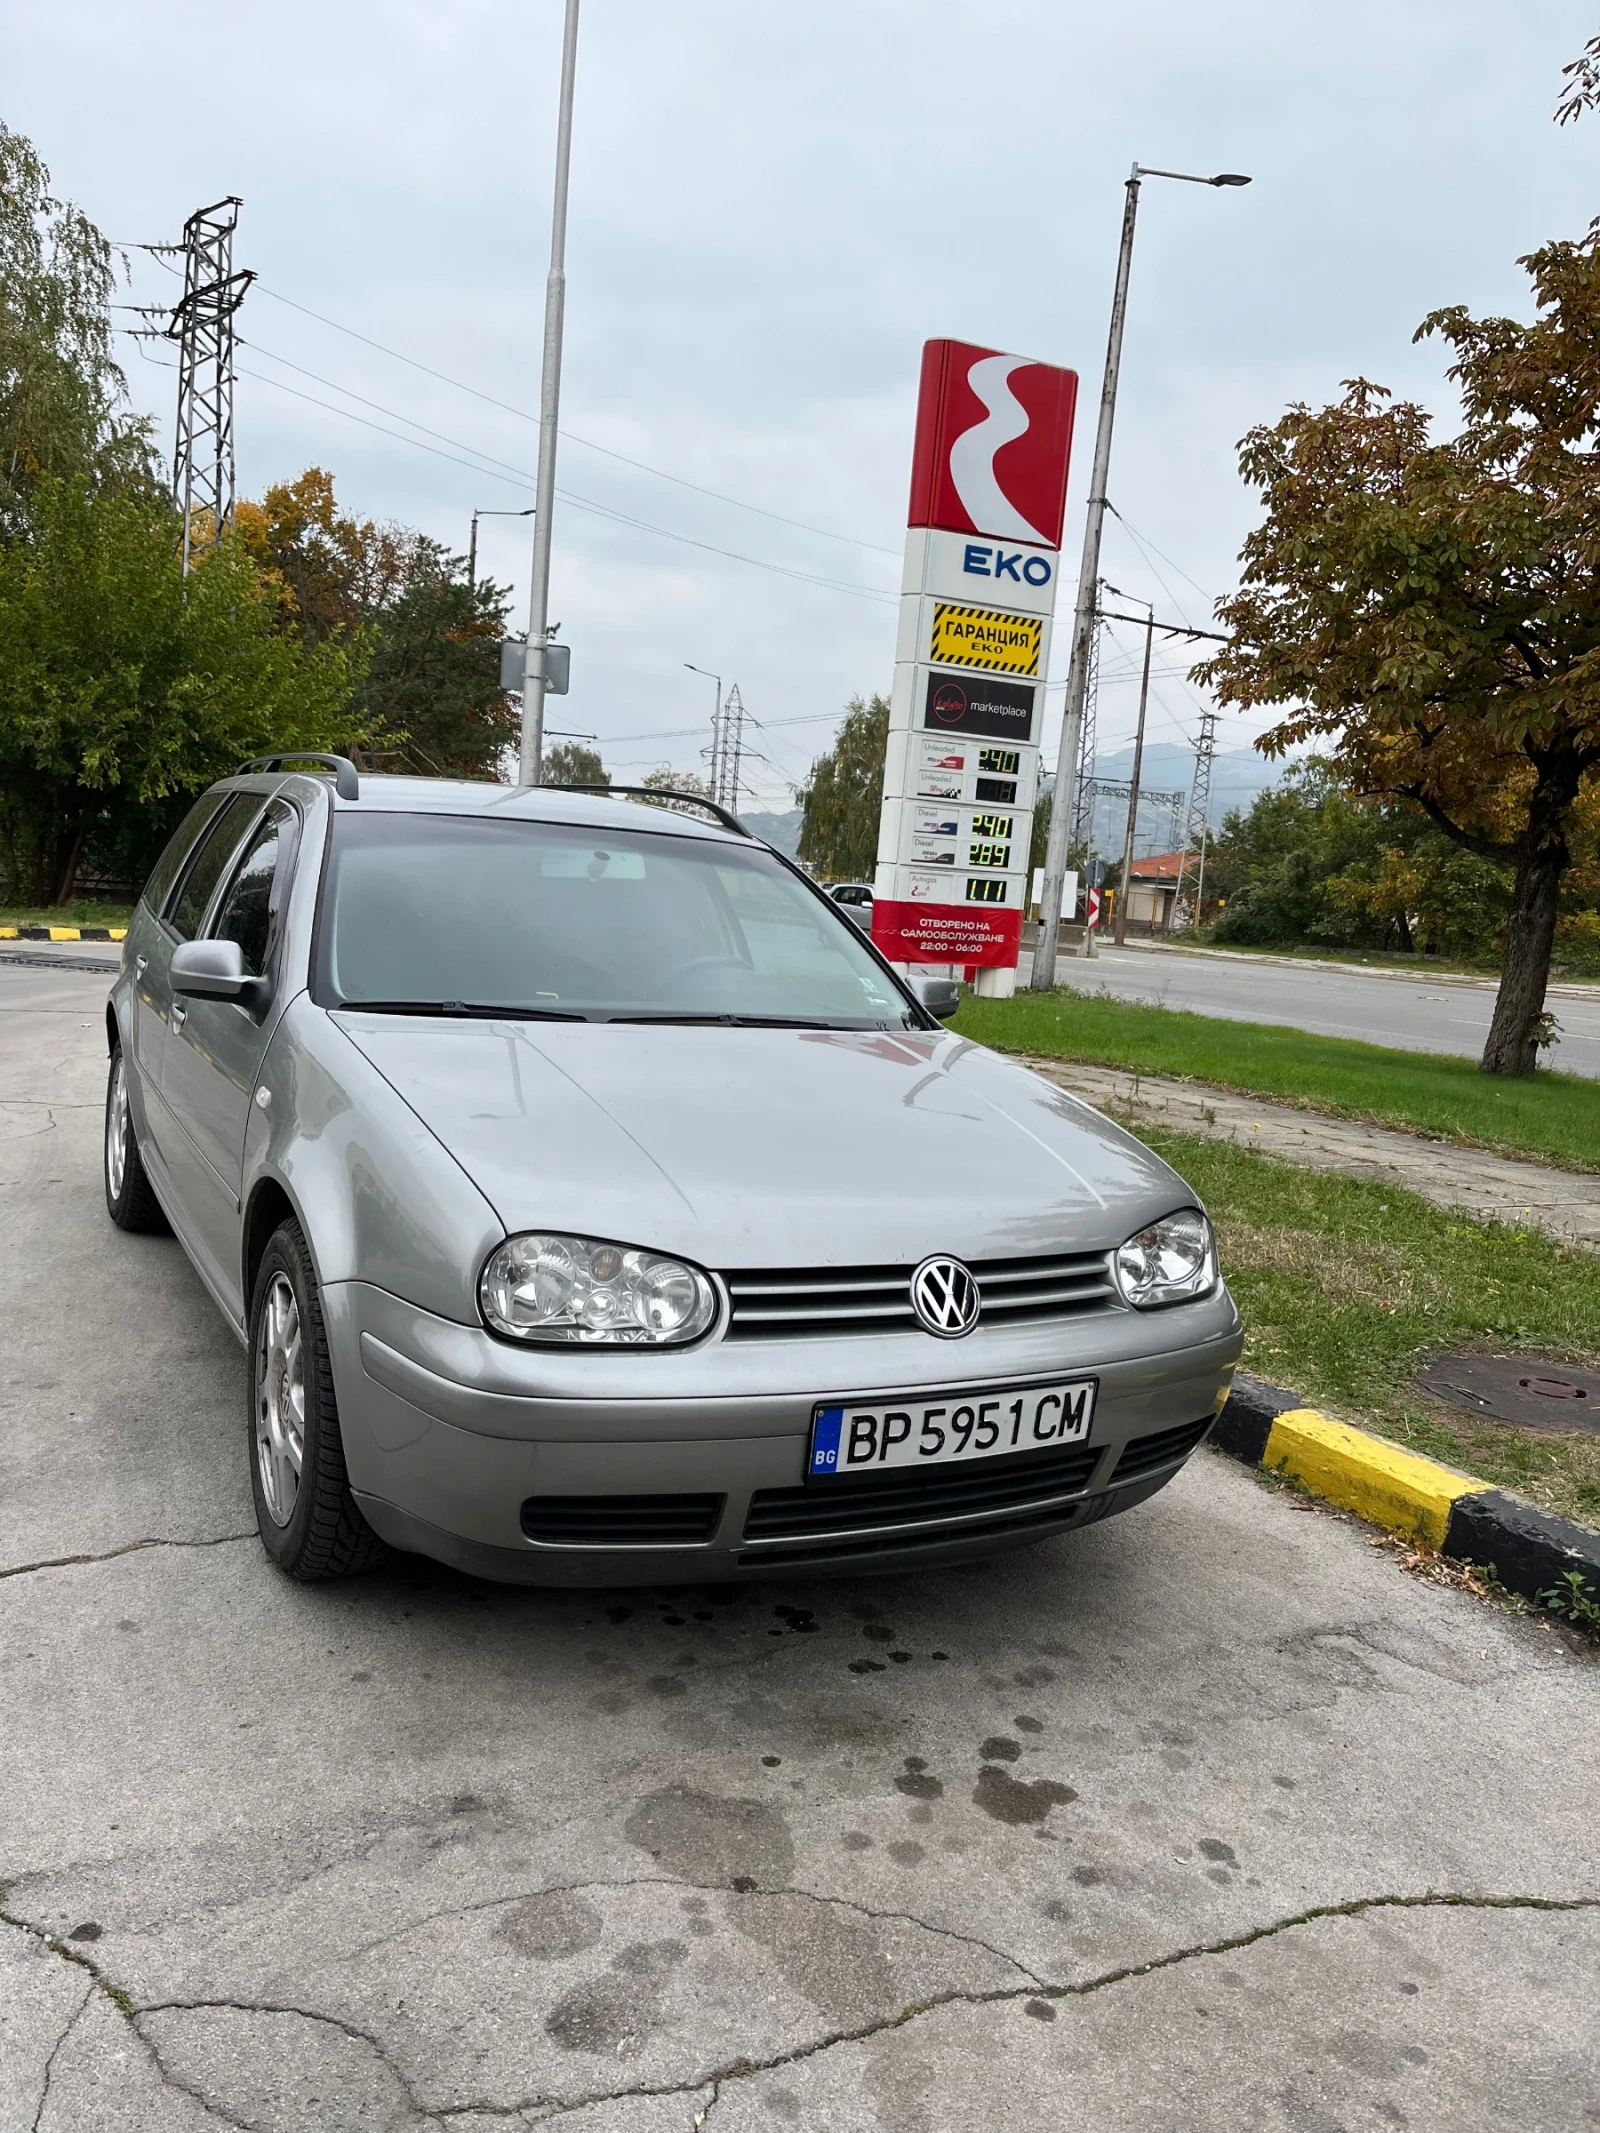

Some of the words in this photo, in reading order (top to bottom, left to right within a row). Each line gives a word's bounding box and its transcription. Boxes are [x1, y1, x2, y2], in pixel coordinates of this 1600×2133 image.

[963, 544, 1052, 586] EKO
[945, 621, 1030, 648] ГАРАНЦИЯ
[970, 702, 1027, 717] marketplace
[924, 743, 956, 753] Unleaded
[978, 749, 1017, 773] 2.40
[921, 773, 952, 783] Unleaded
[918, 809, 938, 818] Diesel
[972, 814, 1010, 838] 2.40
[914, 839, 934, 847] Diesel
[969, 842, 1006, 866] 2.89
[911, 875, 937, 884] Autogas
[920, 918, 975, 930] ОТВОРЕНО
[976, 922, 990, 931] НА
[901, 929, 1004, 942] САМООБСЛУЖВАНЕ
[920, 942, 948, 951] 22:00
[955, 944, 983, 952] 06:00
[919, 1399, 1024, 1456] 5951
[815, 1449, 836, 1465] BG
